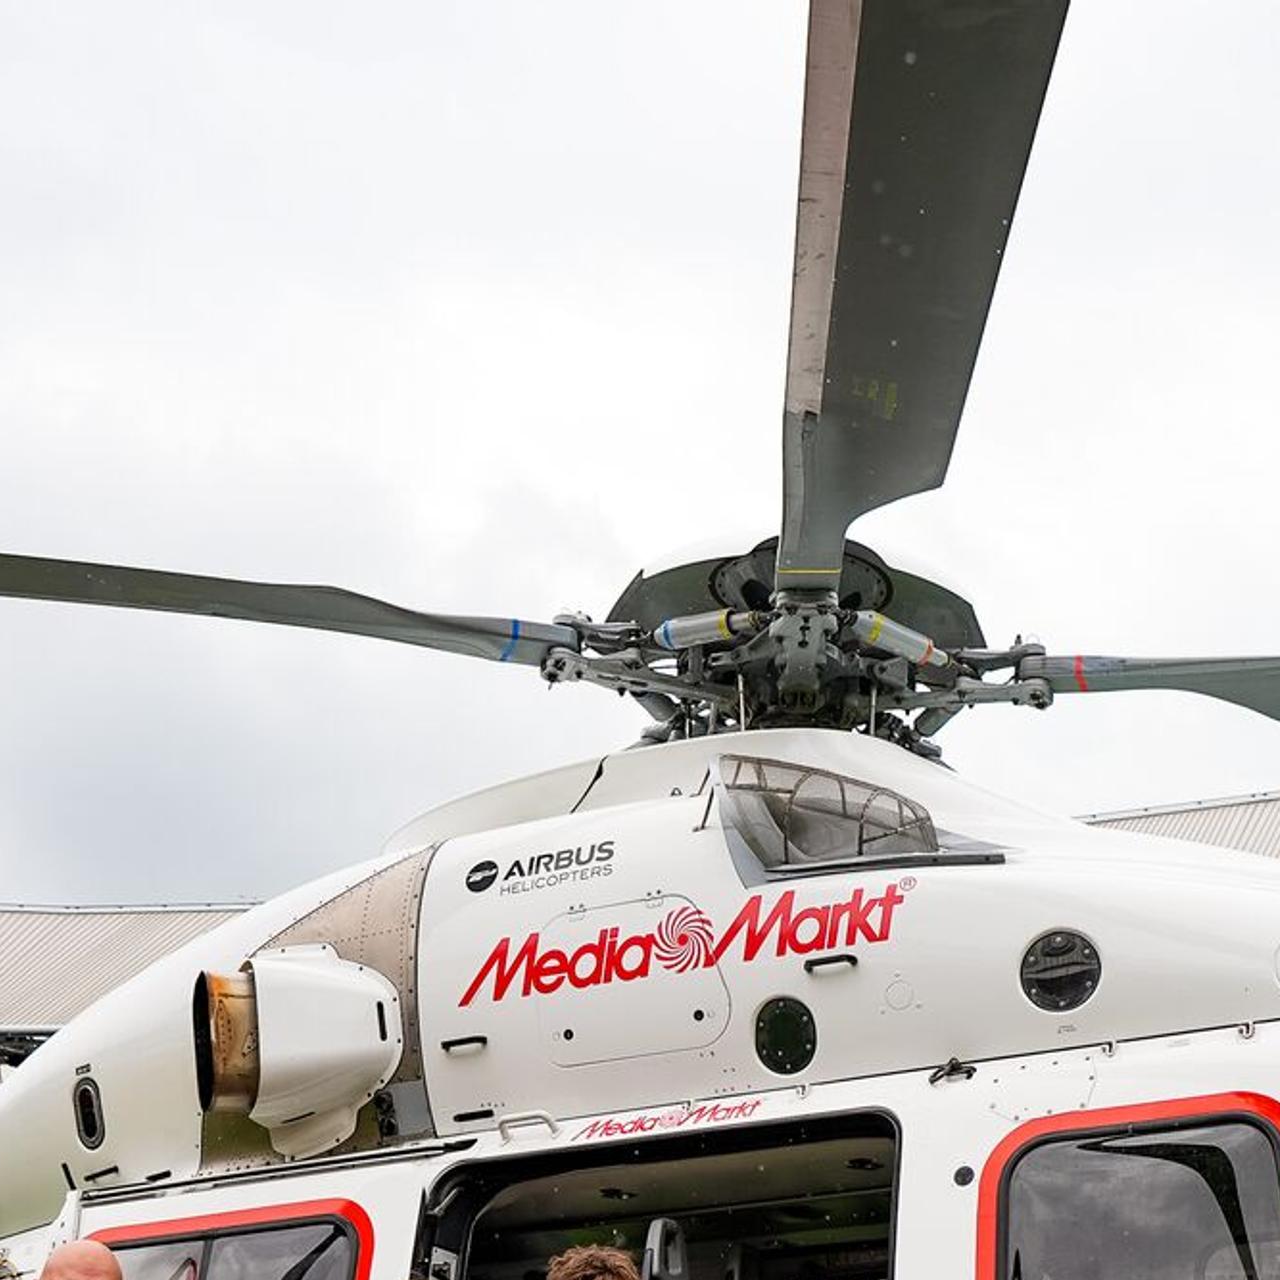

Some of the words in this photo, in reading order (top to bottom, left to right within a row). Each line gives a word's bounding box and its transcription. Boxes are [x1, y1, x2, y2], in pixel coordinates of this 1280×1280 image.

[500, 864, 614, 896] HELICOPTERS
[503, 841, 615, 881] AIRBUS
[458, 926, 656, 1008] Media
[570, 1117, 660, 1142] Media
[677, 1100, 762, 1126] Markt
